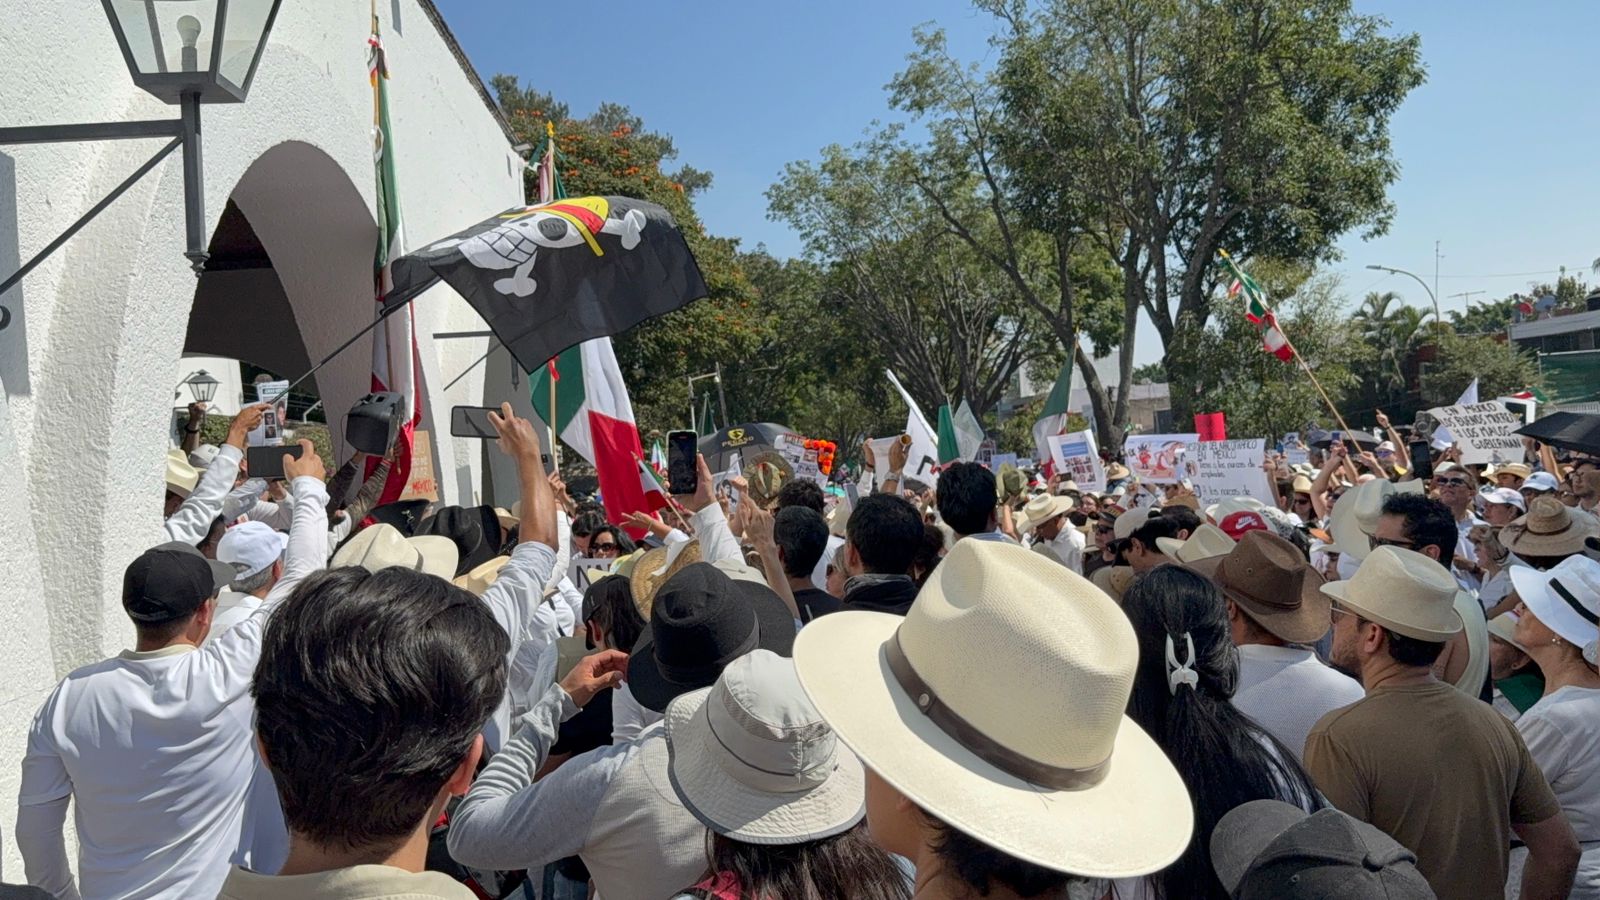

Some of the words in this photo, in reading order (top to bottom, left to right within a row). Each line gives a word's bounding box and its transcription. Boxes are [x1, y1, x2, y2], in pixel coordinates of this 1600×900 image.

[1442, 406, 1459, 417] EN
[1462, 402, 1497, 414] MEXICO
[1440, 416, 1457, 428] LOS
[1454, 413, 1487, 427] BUENOS
[1462, 427, 1480, 439] LOS
[1480, 425, 1512, 438] MALOS
